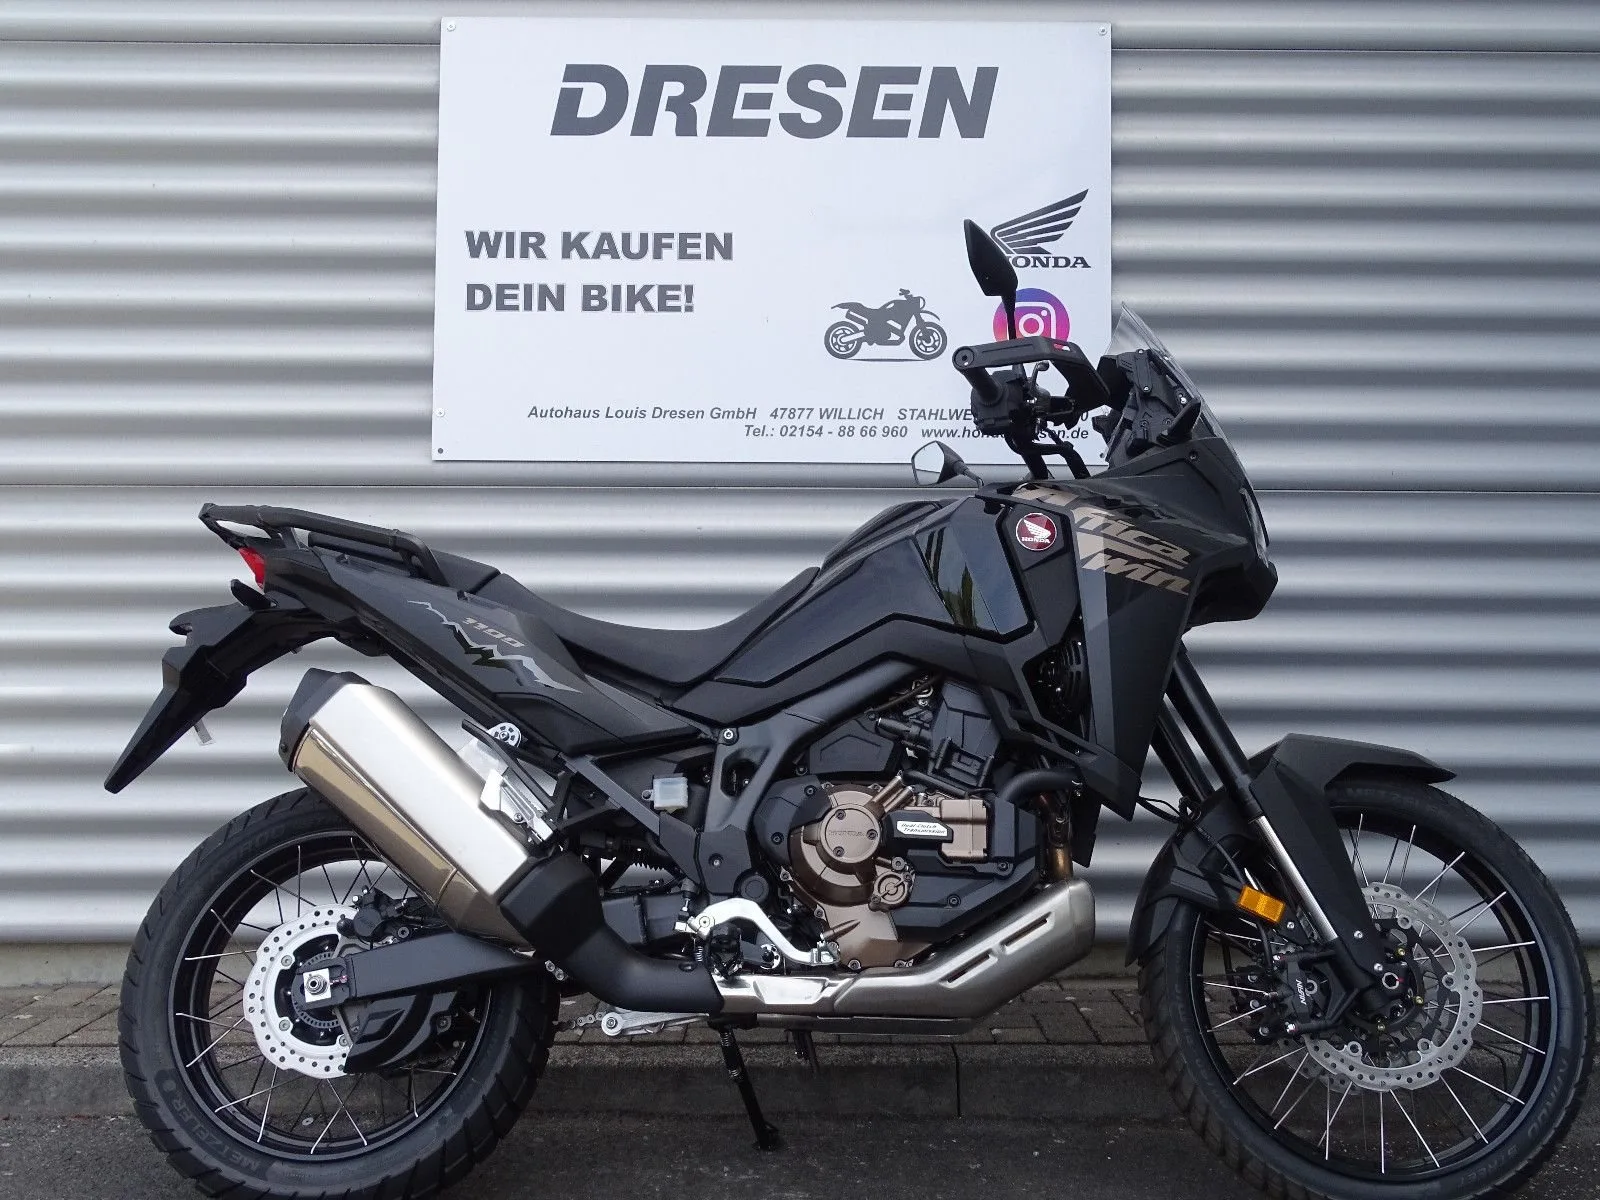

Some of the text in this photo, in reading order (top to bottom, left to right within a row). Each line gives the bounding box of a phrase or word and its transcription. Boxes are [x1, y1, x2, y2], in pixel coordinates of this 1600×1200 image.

[550, 64, 999, 139] DRESEN
[465, 230, 734, 261] WIR KAUFEN
[1007, 256, 1092, 269] ONDA
[466, 283, 694, 313] DEIN BIKE!
[528, 406, 601, 420] Autohaus
[605, 407, 647, 420] Louis
[652, 407, 705, 420] Dresen
[710, 407, 758, 420] GmbH
[769, 407, 815, 421] 47877
[820, 408, 885, 421] WILLICH
[897, 408, 974, 421] STAHLWE
[744, 425, 775, 438] Tel.:
[779, 425, 824, 438] 02154
[838, 426, 856, 438] 88
[860, 426, 878, 438] 66
[881, 426, 908, 438] 960
[1021, 536, 1051, 544] HONDA
[463, 617, 526, 648] 1100
